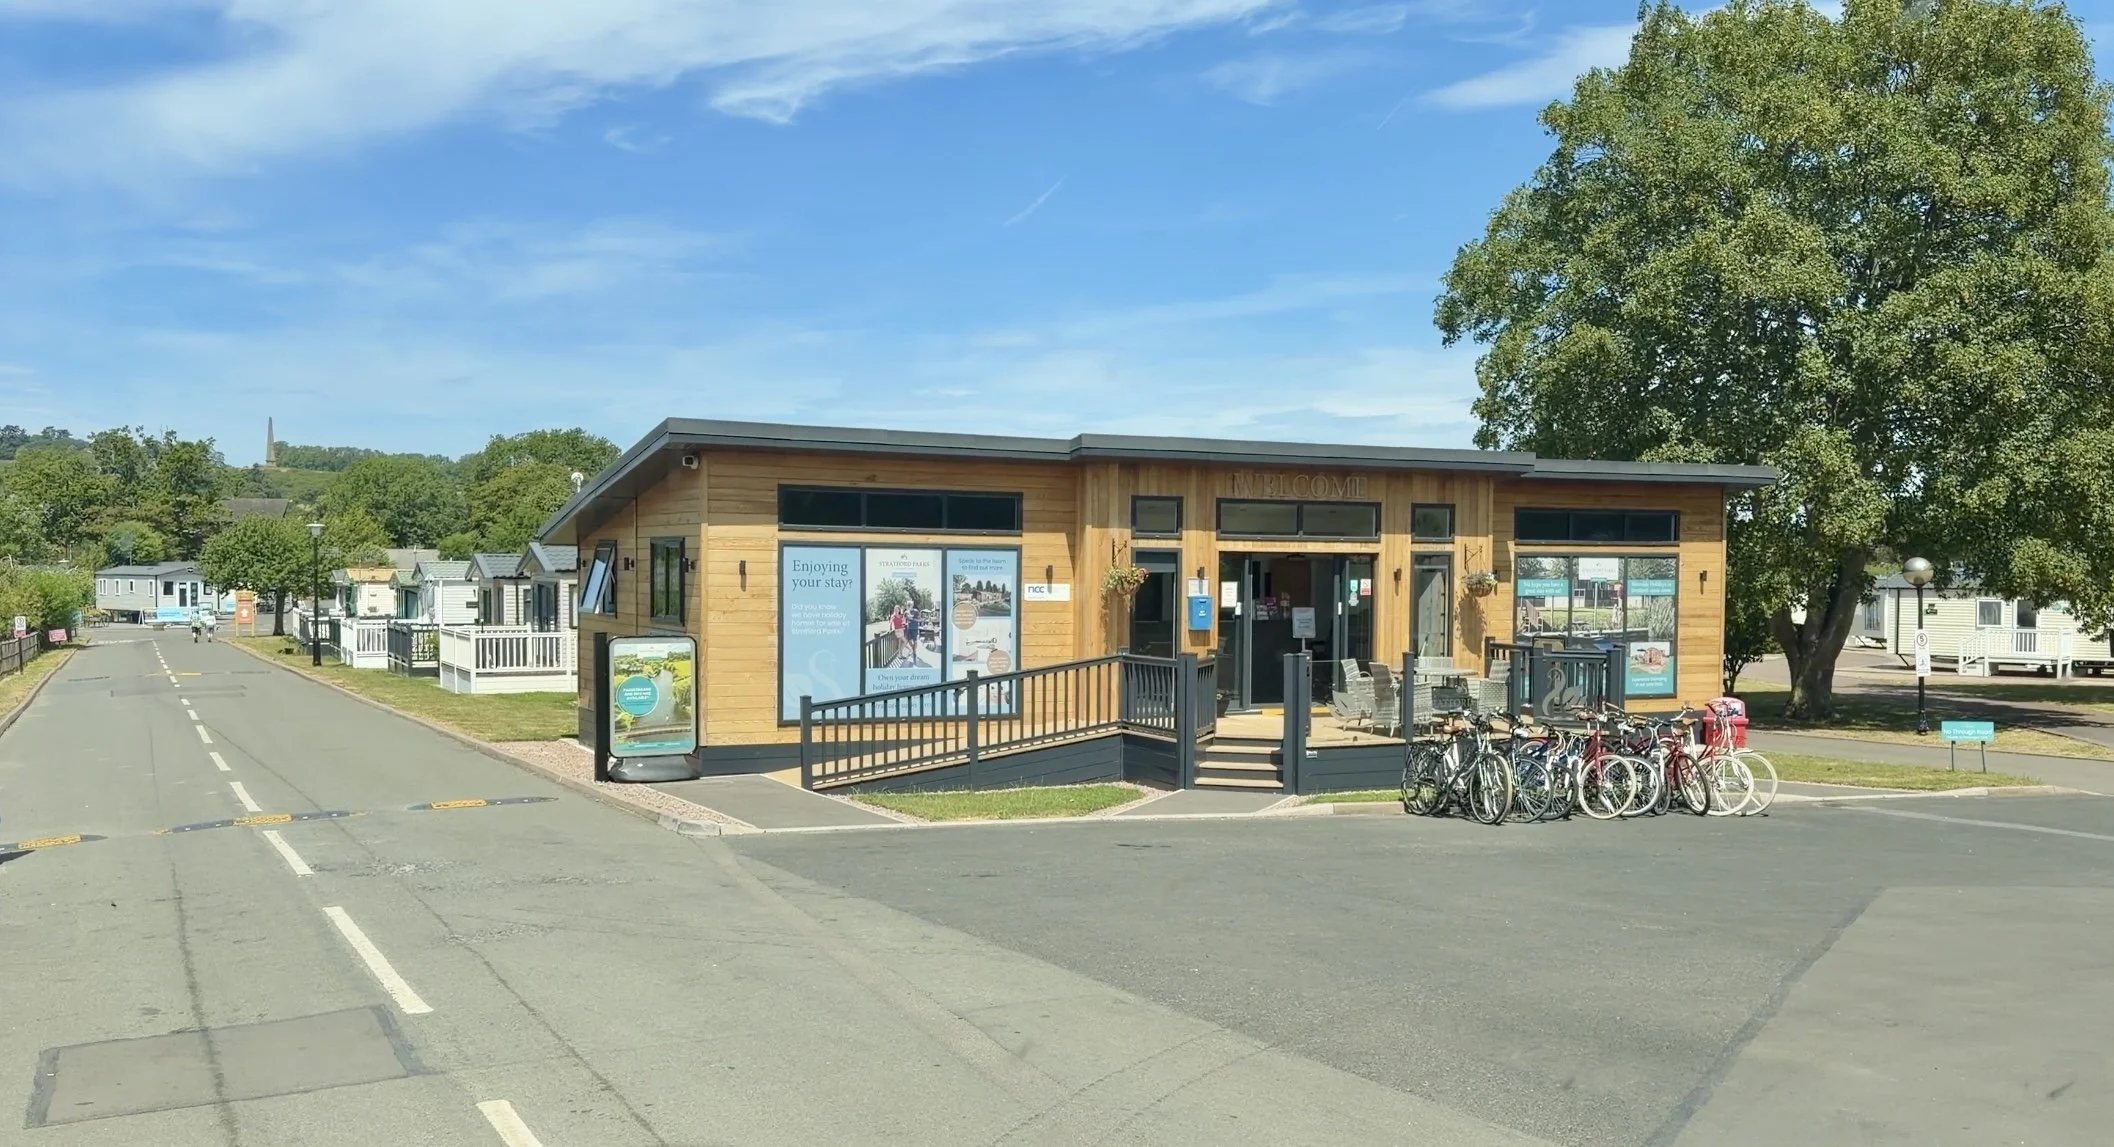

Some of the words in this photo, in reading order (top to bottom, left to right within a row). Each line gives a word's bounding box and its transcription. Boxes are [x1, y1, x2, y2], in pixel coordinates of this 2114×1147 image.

[1232, 473, 1367, 498] WELCOME
[792, 559, 849, 577] Enjoying
[791, 578, 822, 592] your
[824, 577, 853, 592] stay?
[820, 611, 847, 620] holiday
[872, 683, 895, 691] holiday
